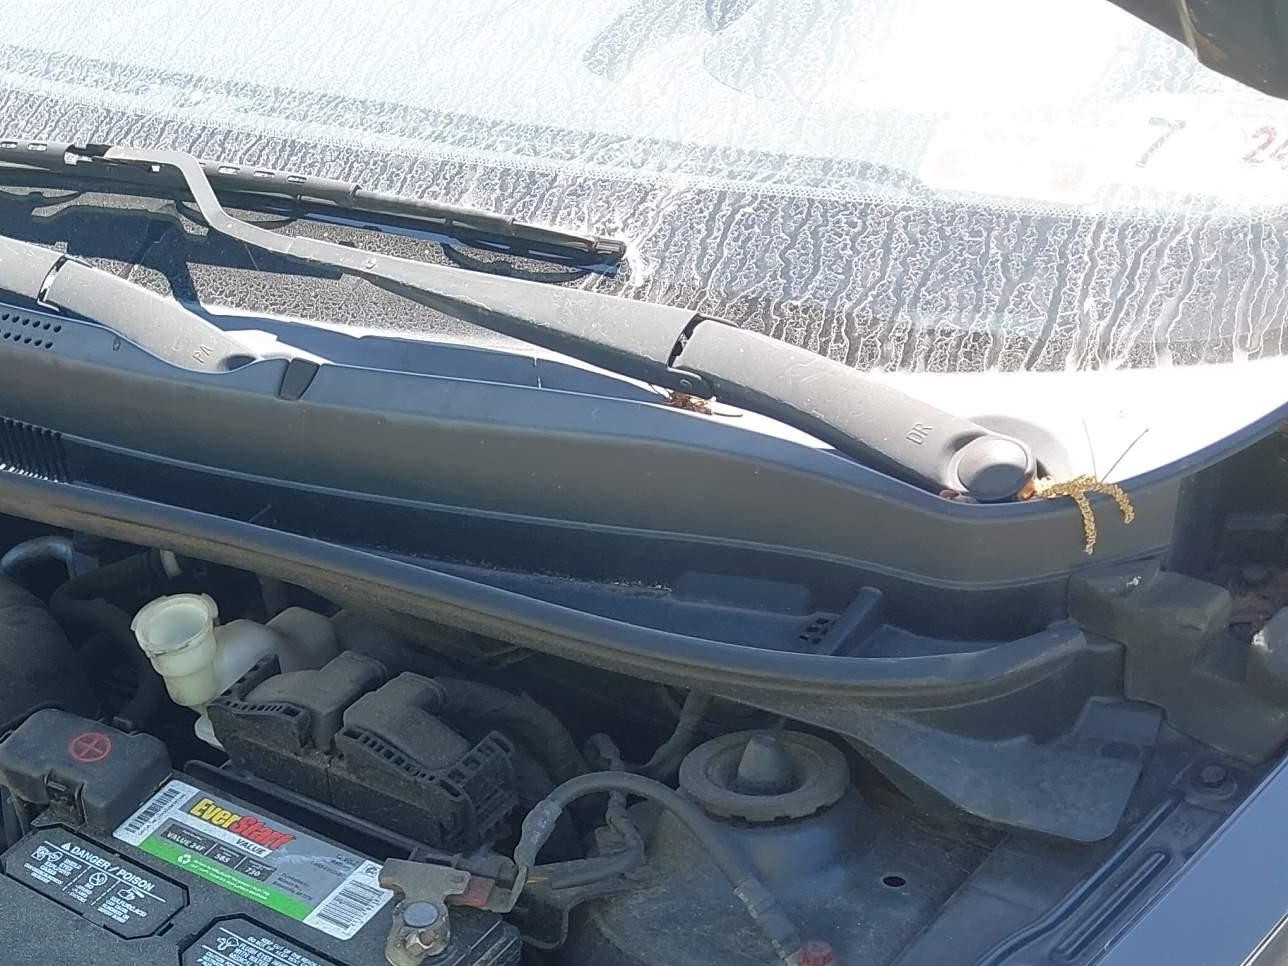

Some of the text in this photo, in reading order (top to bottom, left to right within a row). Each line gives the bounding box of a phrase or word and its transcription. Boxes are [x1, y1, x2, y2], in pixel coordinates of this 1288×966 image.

[1135, 115, 1187, 169] 7
[905, 422, 934, 446] DR
[189, 797, 297, 851] EverStart
[234, 837, 266, 858] VALUE
[69, 845, 112, 871] DANGER
[116, 867, 156, 892] POISON
